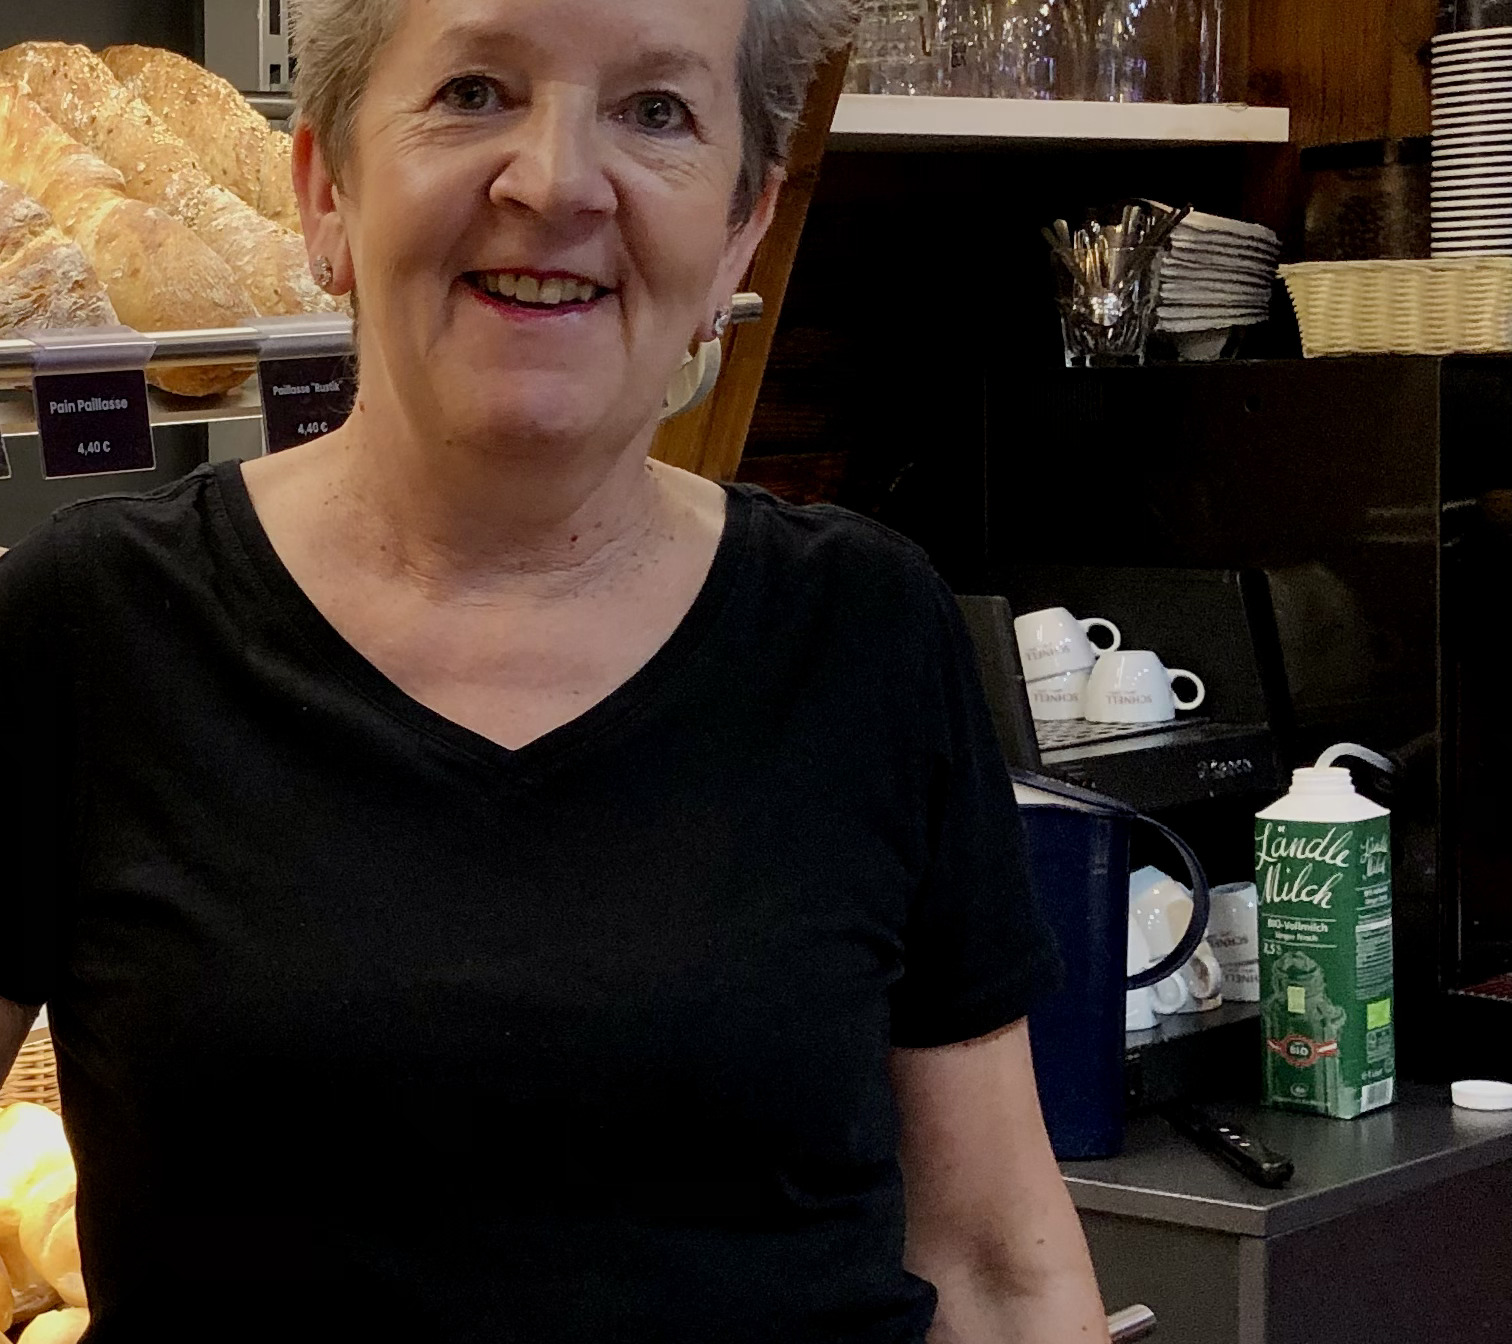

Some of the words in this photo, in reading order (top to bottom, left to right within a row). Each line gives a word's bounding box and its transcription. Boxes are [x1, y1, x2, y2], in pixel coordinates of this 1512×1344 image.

[49, 400, 76, 414] Pain
[77, 397, 128, 413] Paillasse
[77, 441, 100, 456] 4,40
[102, 441, 111, 453] €
[1255, 822, 1353, 870] Ländle
[1258, 863, 1344, 909] Milch
